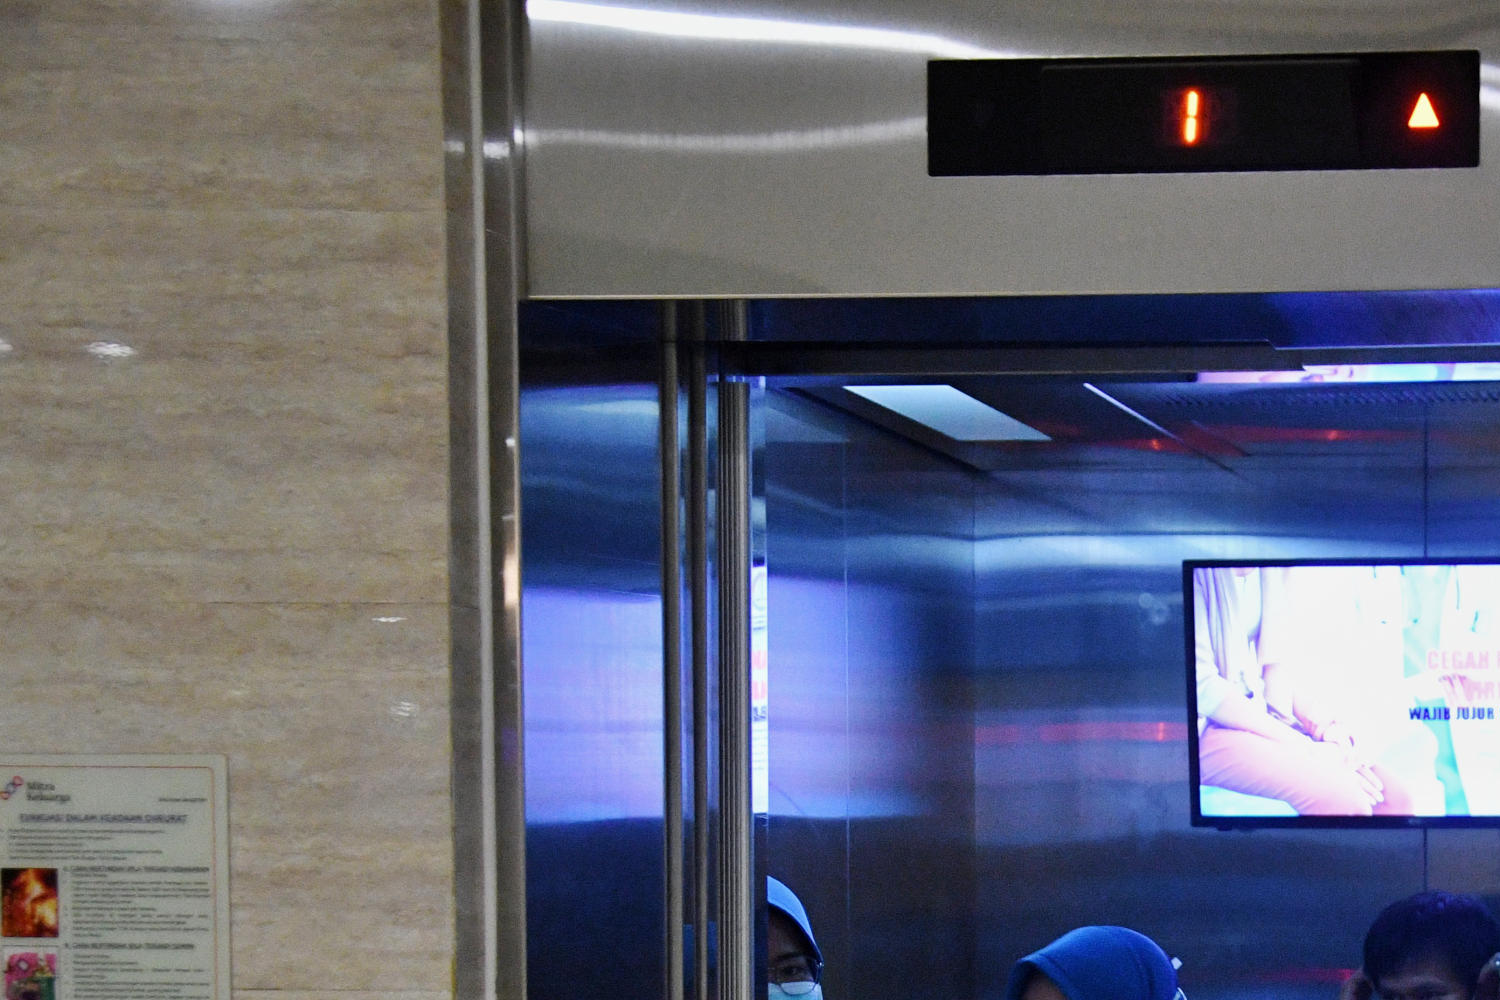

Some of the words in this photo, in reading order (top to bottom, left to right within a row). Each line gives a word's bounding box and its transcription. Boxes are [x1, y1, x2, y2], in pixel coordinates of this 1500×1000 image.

[1183, 89, 1199, 144] 1
[1427, 650, 1489, 670] CEGAH
[1408, 706, 1451, 721] WAJIB
[1456, 706, 1495, 721] JUJUR
